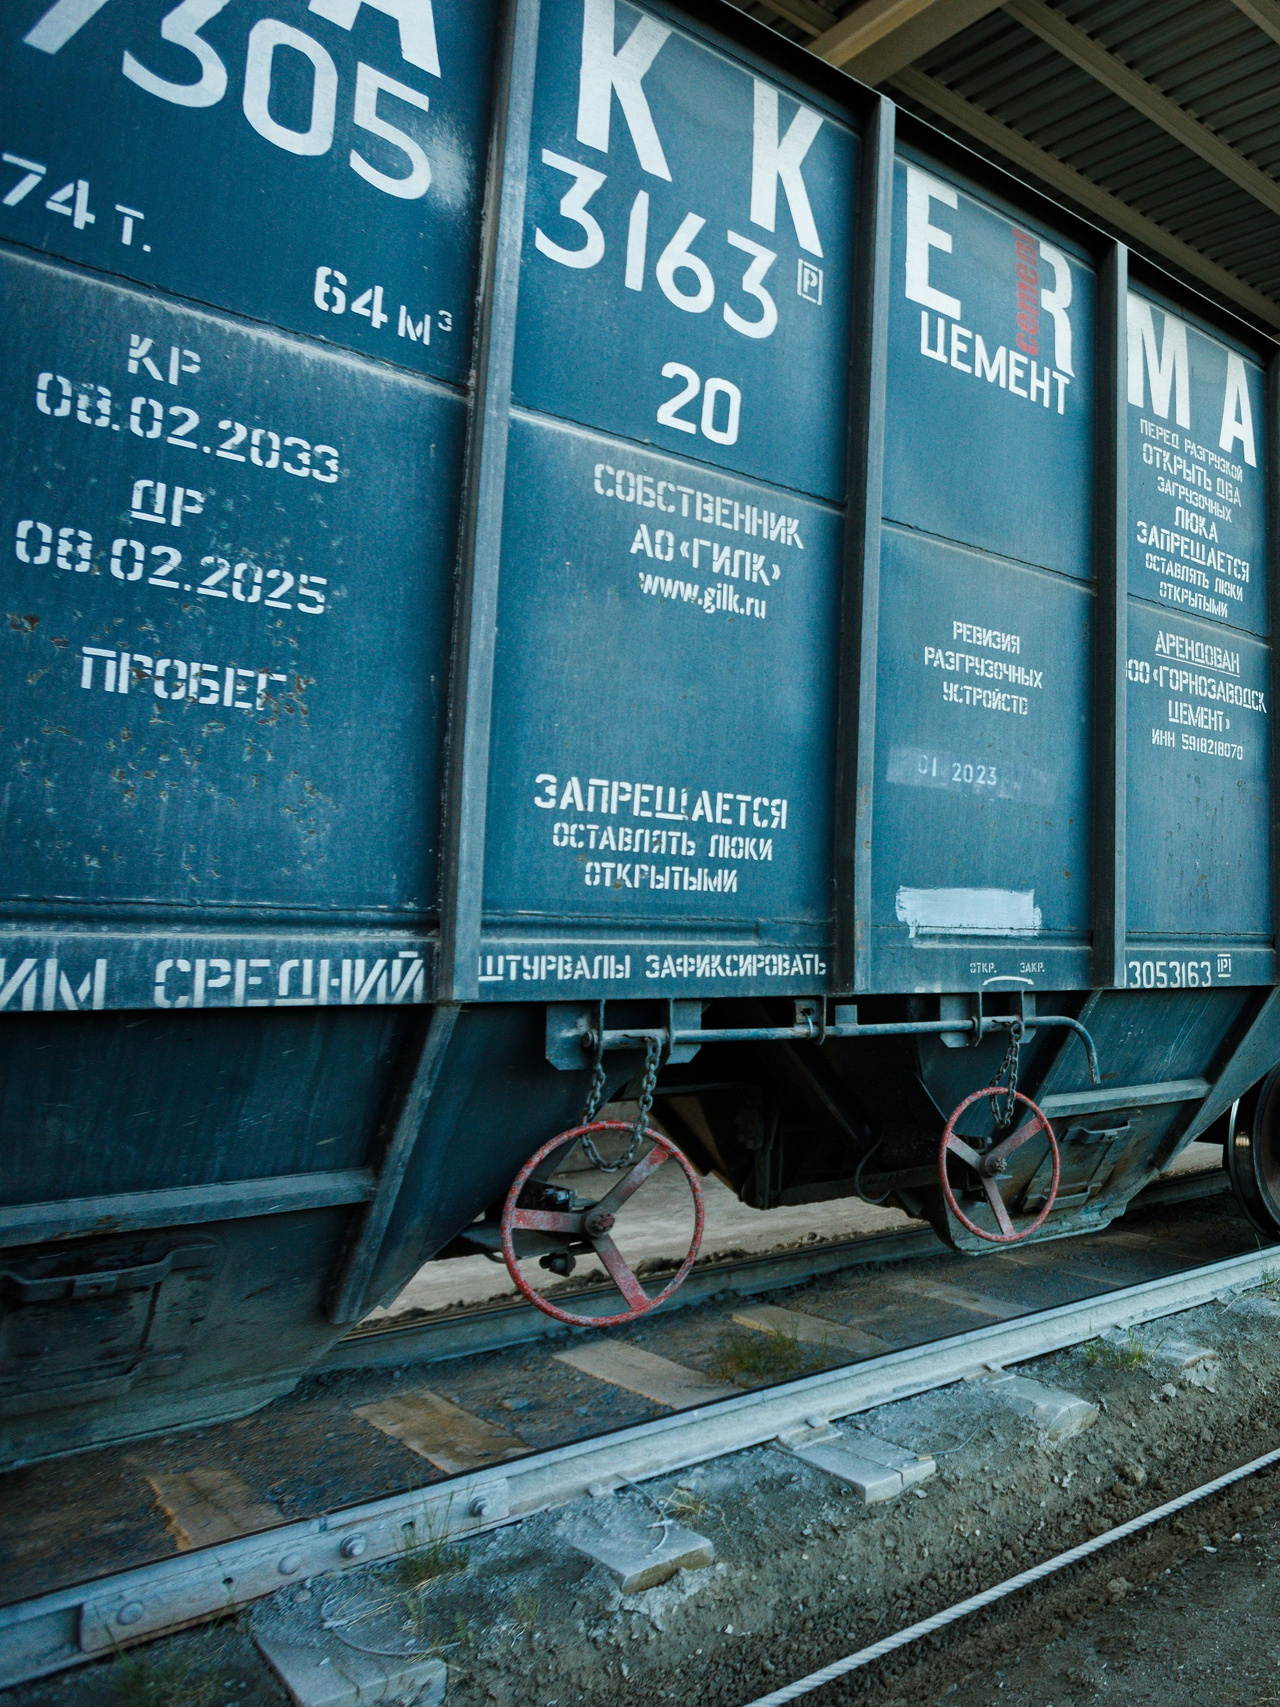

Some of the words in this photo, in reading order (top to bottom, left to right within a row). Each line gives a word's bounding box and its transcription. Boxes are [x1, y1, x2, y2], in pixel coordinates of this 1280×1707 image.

[2, 153, 95, 229] 74
[314, 266, 388, 328] 64
[128, 334, 201, 386] КР
[920, 311, 1071, 416] ЦЕМЕНТ
[36, 372, 339, 483] 08.02.2033
[657, 362, 742, 446] 20
[1140, 418, 1180, 450] ПЕРЕД
[1184, 438, 1243, 483] РАЗГРУЗКОЙ
[1143, 442, 1212, 492] ОТКРЫТЬ
[1216, 477, 1242, 508] ДВА
[130, 479, 205, 527] ДР
[594, 463, 804, 549] СОБСТВЕННИК
[1157, 476, 1232, 523] ЗАГРУЗОЧНЫХ
[630, 524, 674, 562] АО
[1174, 506, 1219, 543] ЛЮКА
[1136, 520, 1250, 583] ЗАПРЕЩАЕТСЯ
[639, 572, 766, 619] www.gilk.ru
[1145, 553, 1209, 590] ОСТАВЛЯТЬ
[1214, 577, 1243, 602] ЛЮКИ
[1159, 581, 1228, 618] ОТКРЫТЫМИ
[953, 620, 1020, 654] РЕВИЗИЯ
[1155, 630, 1240, 674] АРЕНДОВАН
[81, 646, 287, 711] ПРОБЕГ
[925, 646, 1043, 689] РАЗГРУЗОЧНЫХ
[1126, 658, 1150, 684] ОО
[1152, 665, 1267, 714] «ГОРНОЗАВОДСК
[943, 681, 1028, 715] УСТРОЙСТВ
[1152, 728, 1176, 748] ИНН
[1181, 733, 1244, 761] 5918218070
[952, 762, 998, 785] 2023
[534, 774, 788, 829] ЗАПРЕЩАЕТСЯ
[552, 822, 696, 857] ОСТАВЛЯТЬ
[708, 834, 773, 861] ЛЮКИ
[584, 862, 738, 893] ОТКРЫТЫМИ
[153, 951, 424, 1008] СРЕДНИЙ
[478, 955, 631, 981] ШТУРВАЛЫ
[645, 954, 826, 979] ЗАФИКСИРОВАТЬ
[969, 962, 997, 974] ОТКР.
[1020, 962, 1045, 973] ЗАКР.
[1124, 960, 1212, 988] 3053163
